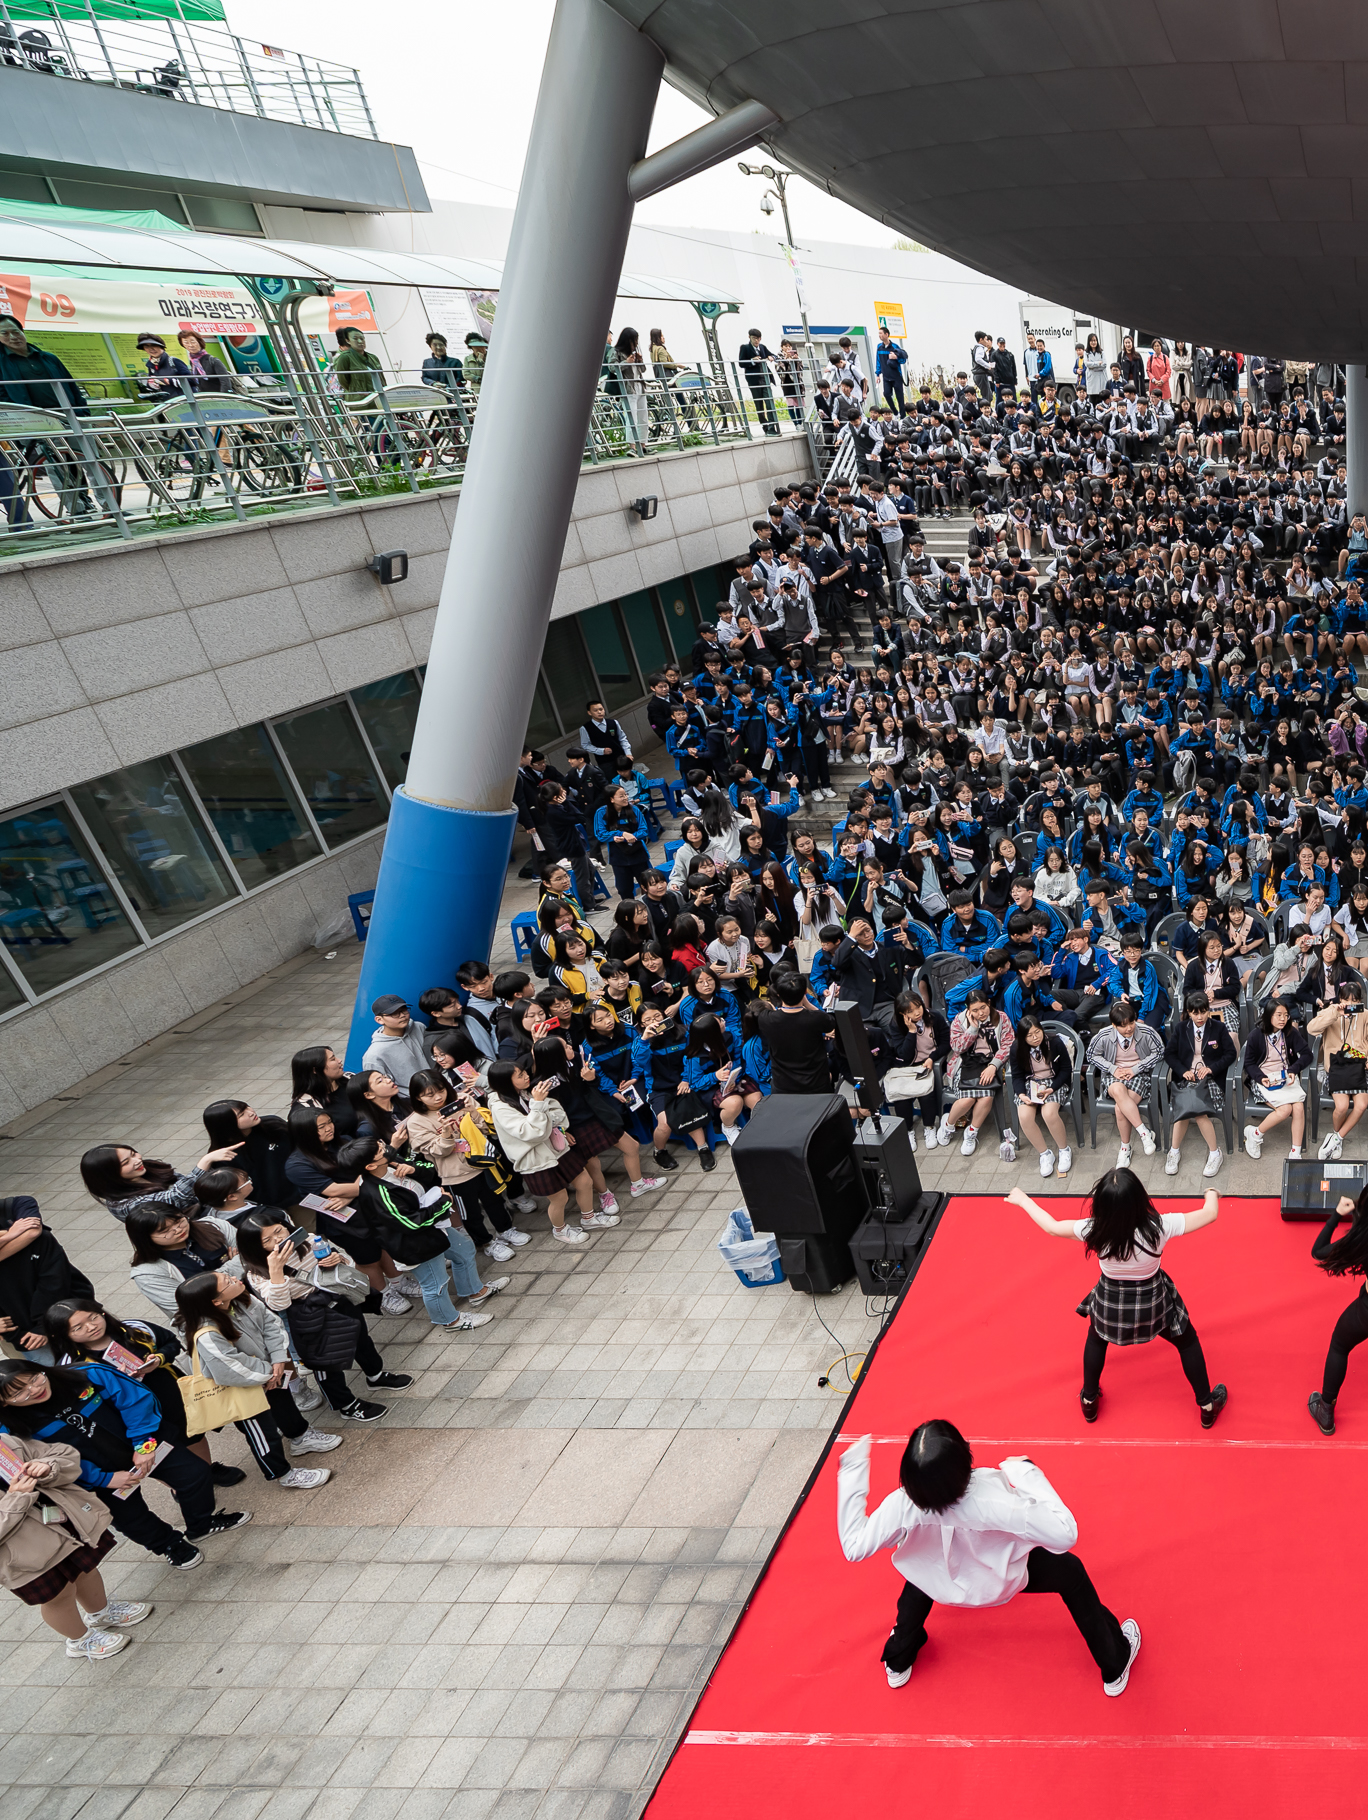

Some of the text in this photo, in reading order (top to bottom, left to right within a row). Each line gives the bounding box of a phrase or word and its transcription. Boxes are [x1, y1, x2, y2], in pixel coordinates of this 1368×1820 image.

[175, 288, 192, 297] 2019
[40, 292, 76, 318] 09
[1062, 327, 1073, 336] Car
